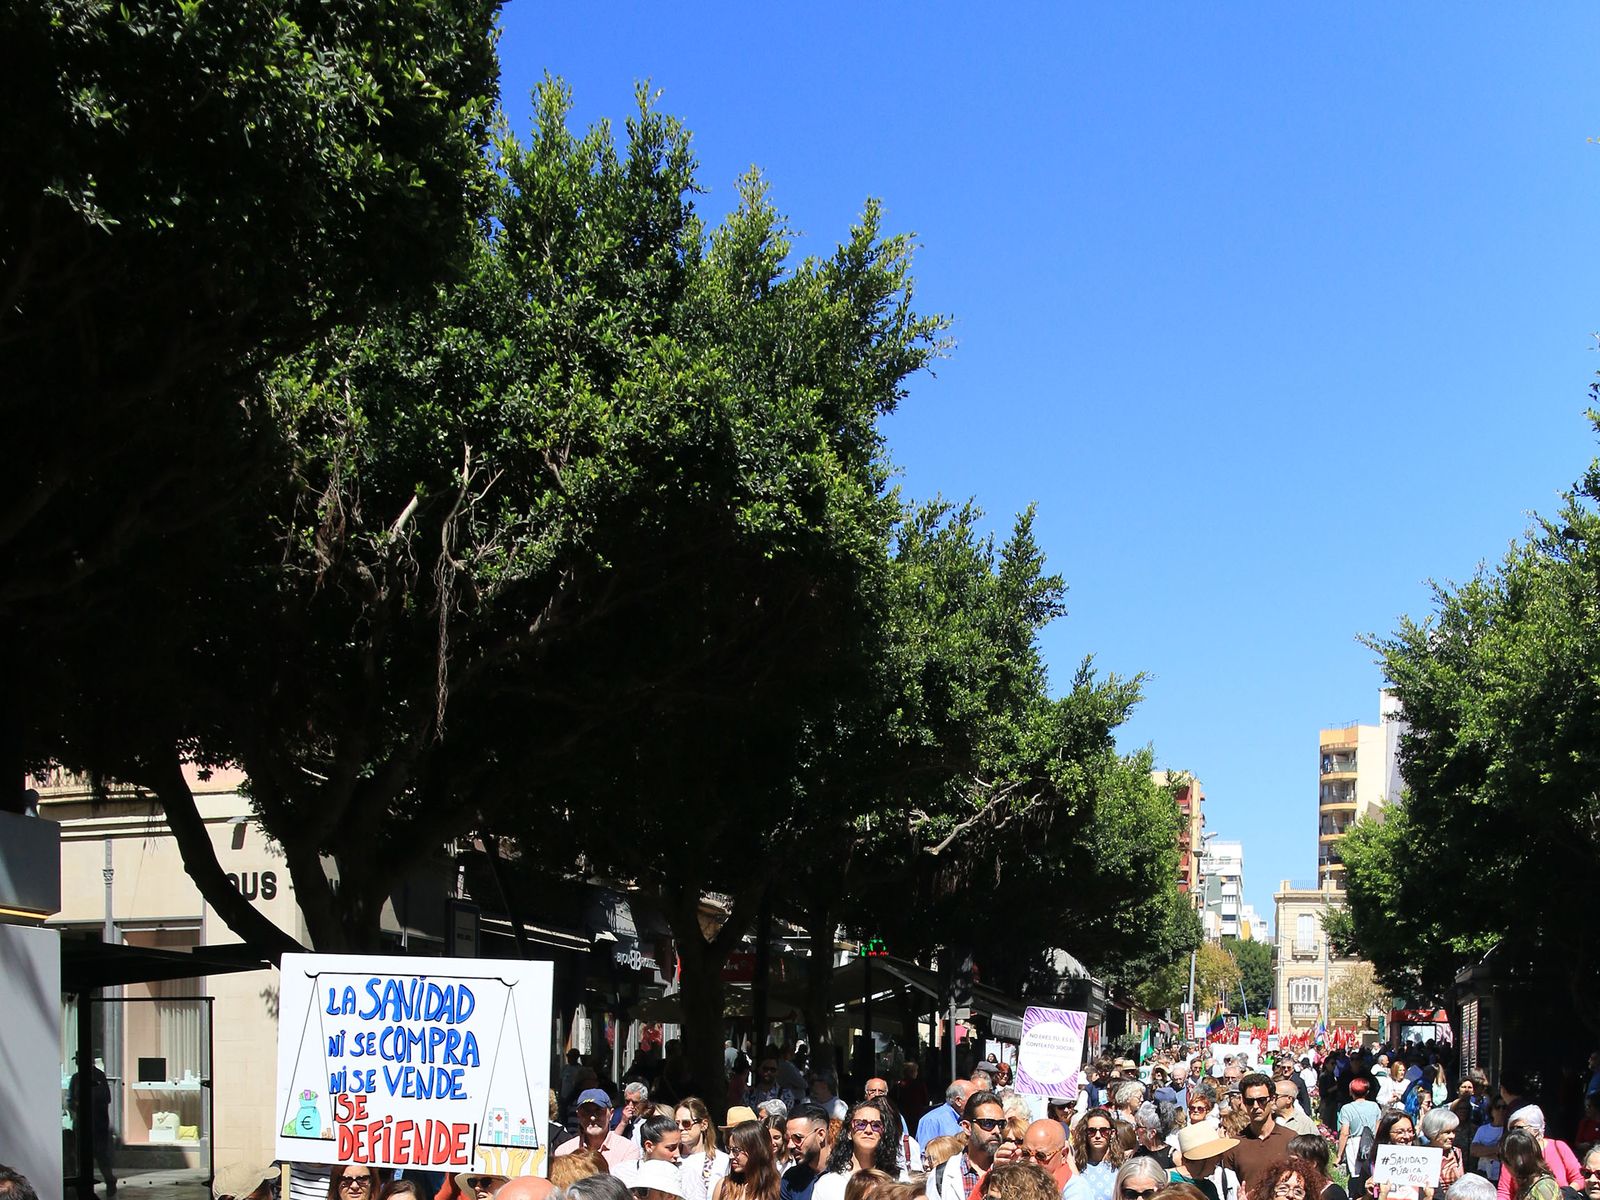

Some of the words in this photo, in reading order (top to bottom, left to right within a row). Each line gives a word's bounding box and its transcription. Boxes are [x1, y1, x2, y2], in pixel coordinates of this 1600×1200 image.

[225, 871, 277, 901] OUS
[326, 985, 356, 1015] LA
[359, 975, 475, 1024] SANIDAD
[328, 1030, 346, 1057] NI
[350, 1031, 376, 1057] SE
[379, 1026, 480, 1067] COMPRA
[1026, 1041, 1055, 1050] CONTEXTO
[329, 1065, 347, 1094] NI
[349, 1069, 376, 1093] SE
[382, 1065, 467, 1100] VENDE
[1381, 1153, 1428, 1165] #SANIDAD
